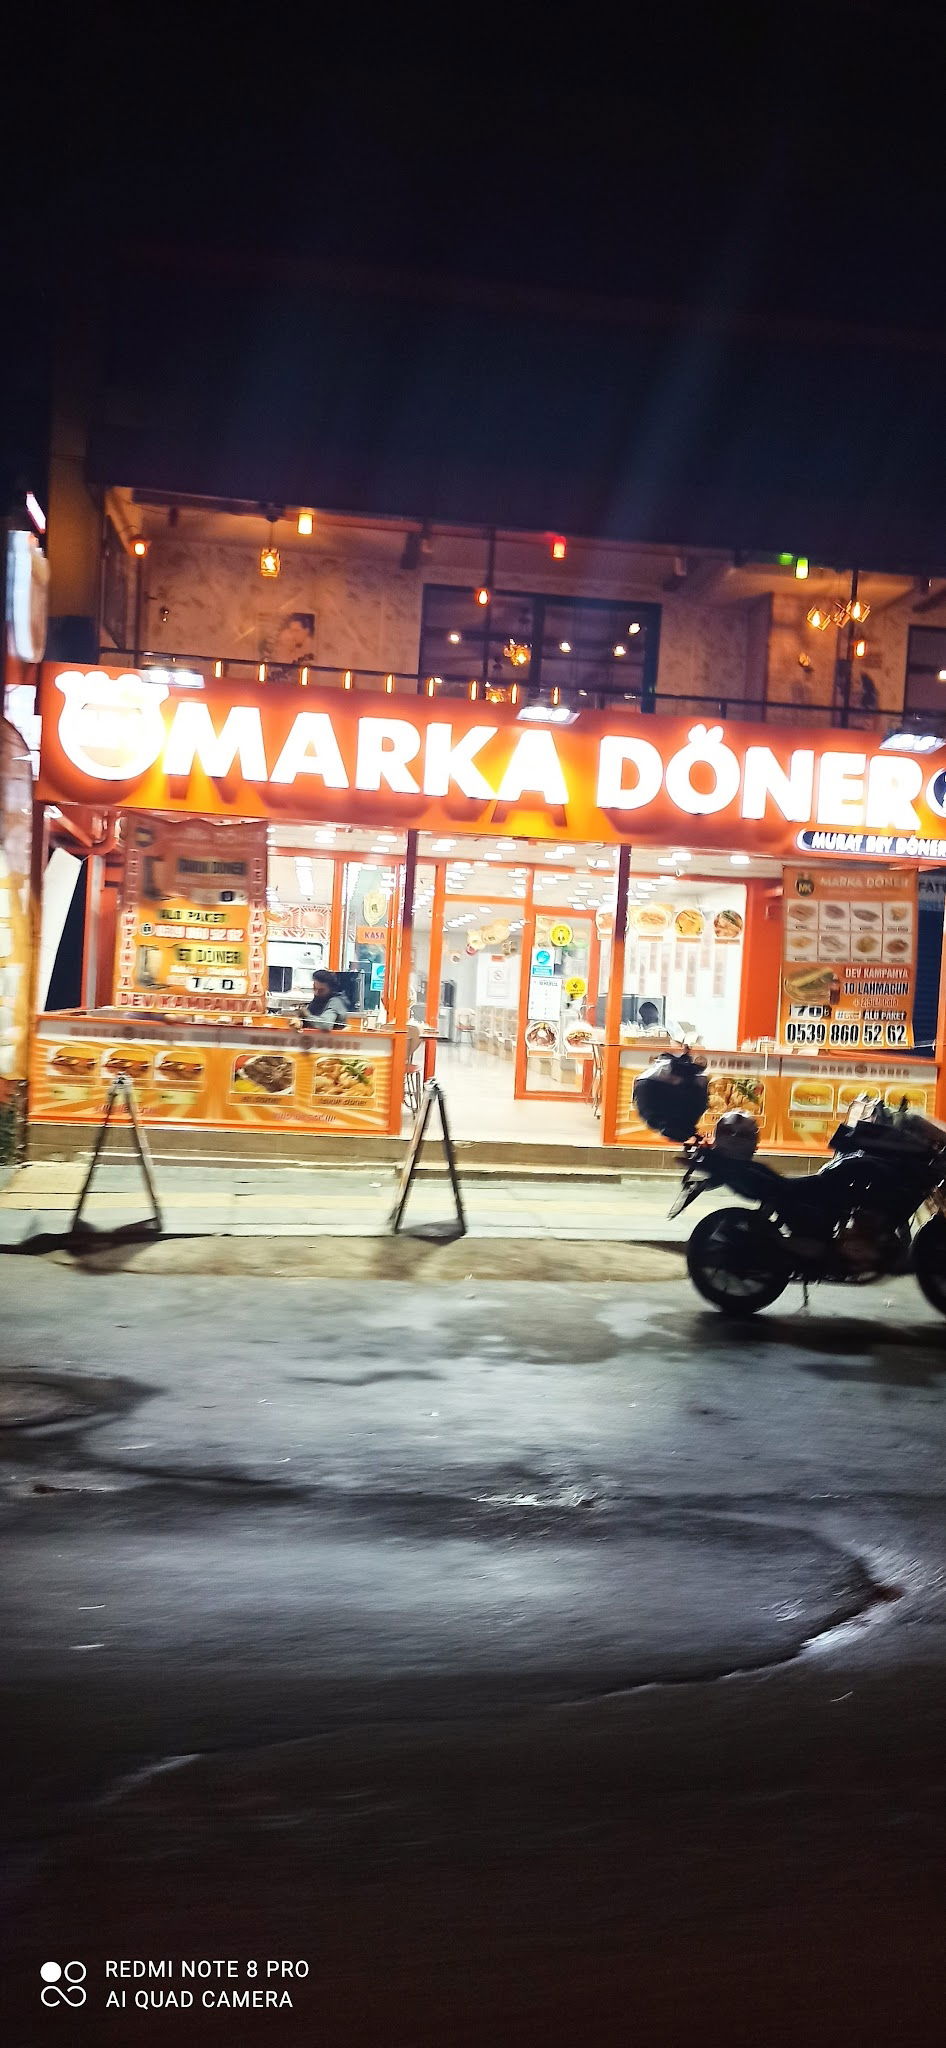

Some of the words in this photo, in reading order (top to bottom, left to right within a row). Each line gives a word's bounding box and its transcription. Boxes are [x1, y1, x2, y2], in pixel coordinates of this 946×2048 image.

[162, 700, 569, 805] MARKA
[597, 723, 922, 830] DÖNER
[811, 831, 863, 852] MURAT
[866, 834, 892, 853] BEY
[896, 834, 946, 857] DÖNER
[364, 931, 385, 940] KASA
[195, 948, 242, 964] DÖNER
[845, 967, 861, 978] DEV
[863, 968, 909, 979] KAMPANYA
[844, 982, 856, 995] 10
[119, 992, 154, 1008] DEV
[881, 1011, 906, 1021] PAKET
[787, 1023, 826, 1044] 0539
[830, 1023, 859, 1045] 860
[863, 1024, 882, 1045] 52
[887, 1024, 907, 1045] 62
